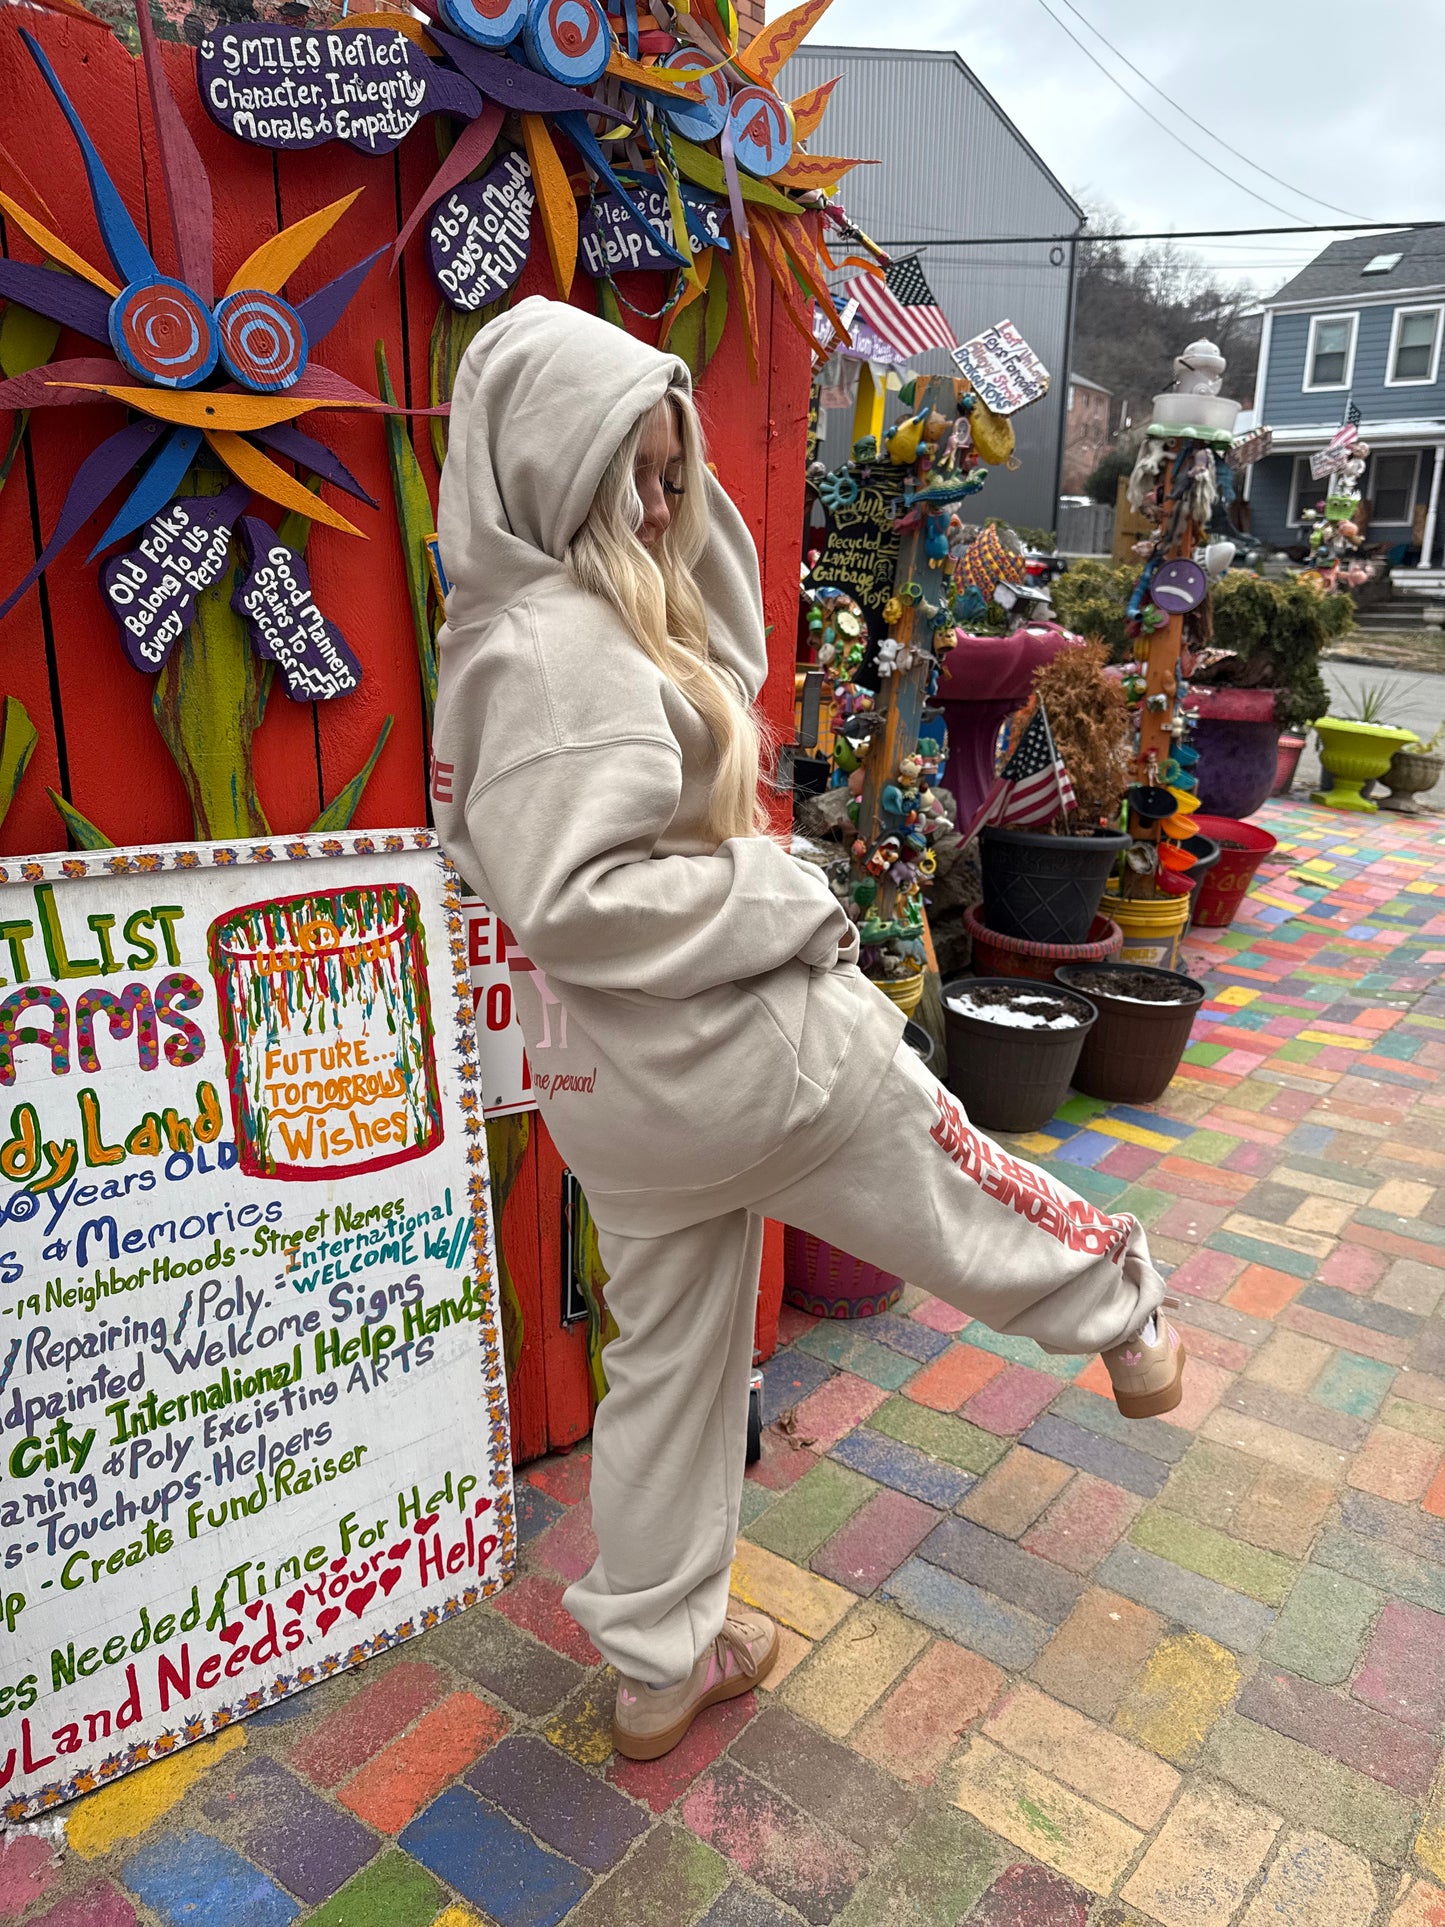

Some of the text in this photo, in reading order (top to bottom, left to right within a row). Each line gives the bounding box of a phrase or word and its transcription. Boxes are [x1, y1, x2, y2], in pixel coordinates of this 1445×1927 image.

[222, 32, 409, 70] SMILES Reflect
[210, 70, 427, 110] Character, Integrity
[232, 110, 314, 140] Morals
[335, 109, 421, 148] Empathy
[431, 194, 470, 252] 365
[438, 151, 532, 292] Days To Mould
[454, 186, 536, 311] Your FUTURE
[582, 225, 643, 273] Help
[954, 347, 1012, 410] Broken Toys
[108, 505, 190, 605] Old Folks
[822, 550, 875, 570] Landfill
[827, 532, 882, 553] Recycled
[124, 525, 210, 638] Belong To Us
[812, 565, 876, 591] Garbage
[861, 585, 892, 610] Toys
[139, 609, 184, 664] Every
[243, 590, 298, 677] Success
[254, 567, 308, 655] Stairs To
[267, 546, 357, 689] Good Manners
[265, 1066, 407, 1108] TOMORROWS
[549, 1066, 597, 1101] person!
[164, 1141, 240, 1181] OLD
[278, 1108, 409, 1161] Wishes
[76, 1200, 283, 1268] Memories
[284, 1187, 453, 1274] International
[334, 1197, 405, 1236] Names
[292, 1231, 419, 1295] WELCOME
[0, 1273, 424, 1437] dpainted Welcome Signs
[9, 1416, 97, 1479] City
[314, 1323, 396, 1375] Help
[401, 1275, 488, 1342] Hands
[203, 1381, 339, 1449] Excisting
[346, 1335, 435, 1395] ARTS
[339, 1511, 389, 1557] For
[397, 1471, 478, 1530] Help
[158, 1602, 305, 1713] Needs
[303, 1549, 386, 1607] Your
[418, 1517, 498, 1588] Help
